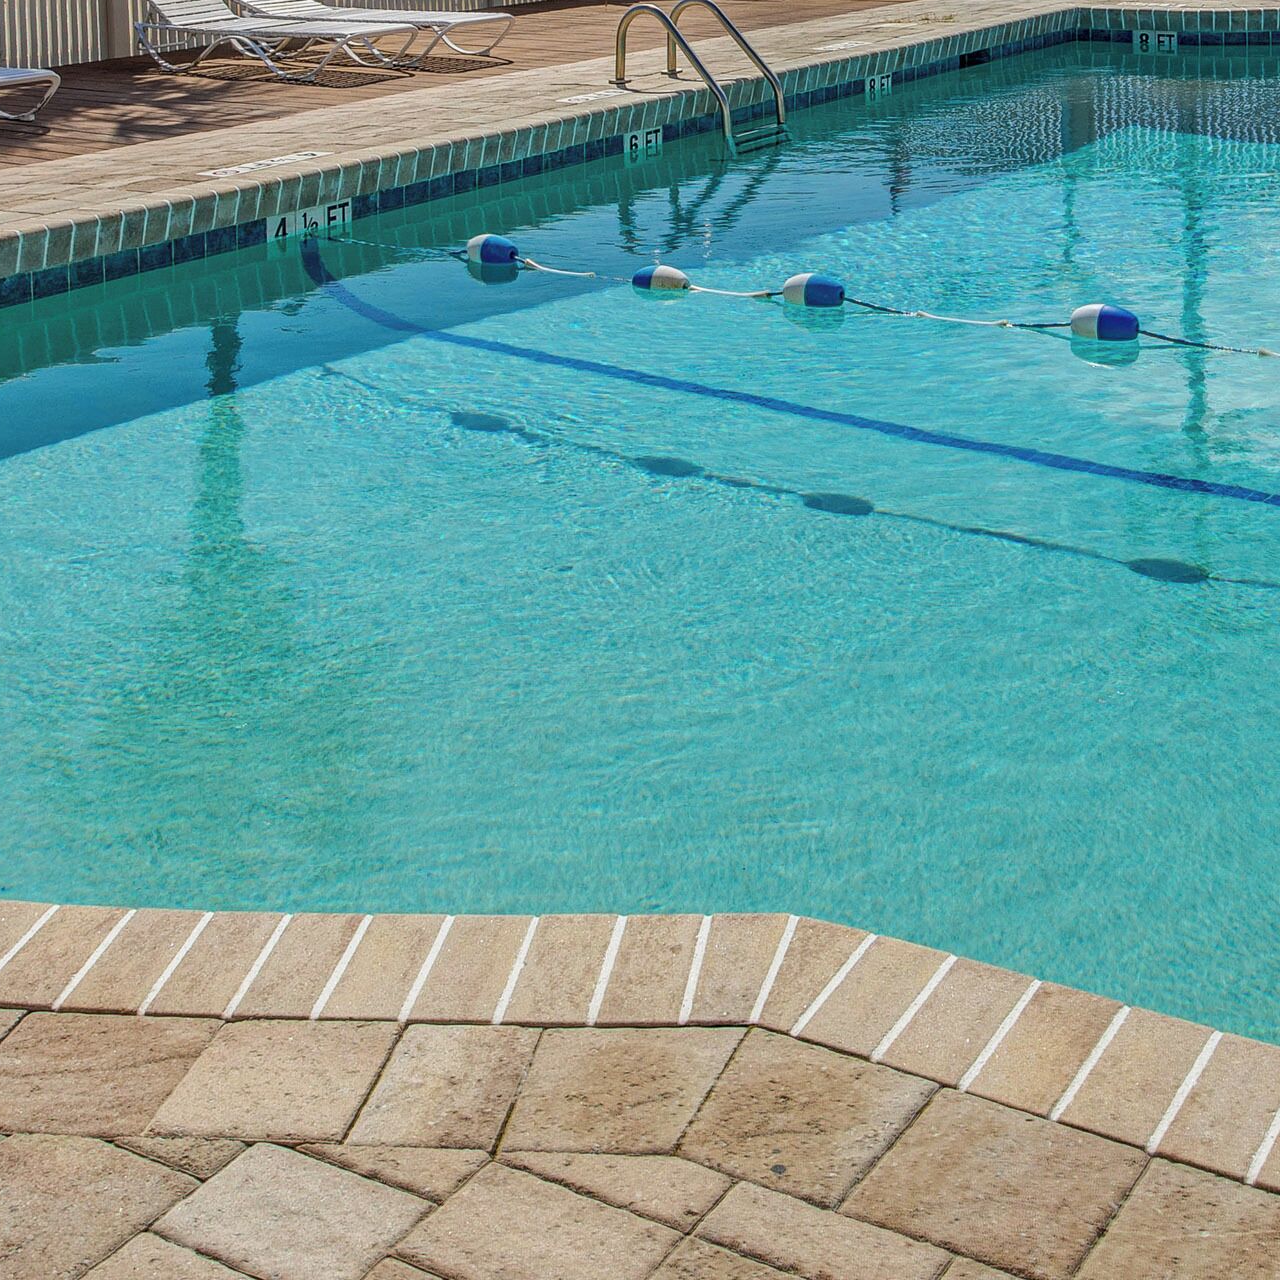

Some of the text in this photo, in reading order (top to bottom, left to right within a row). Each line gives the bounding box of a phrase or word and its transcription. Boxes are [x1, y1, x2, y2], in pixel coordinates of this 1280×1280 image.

[629, 128, 661, 151] 6 FT
[274, 217, 288, 238] 4
[327, 202, 350, 227] FT
